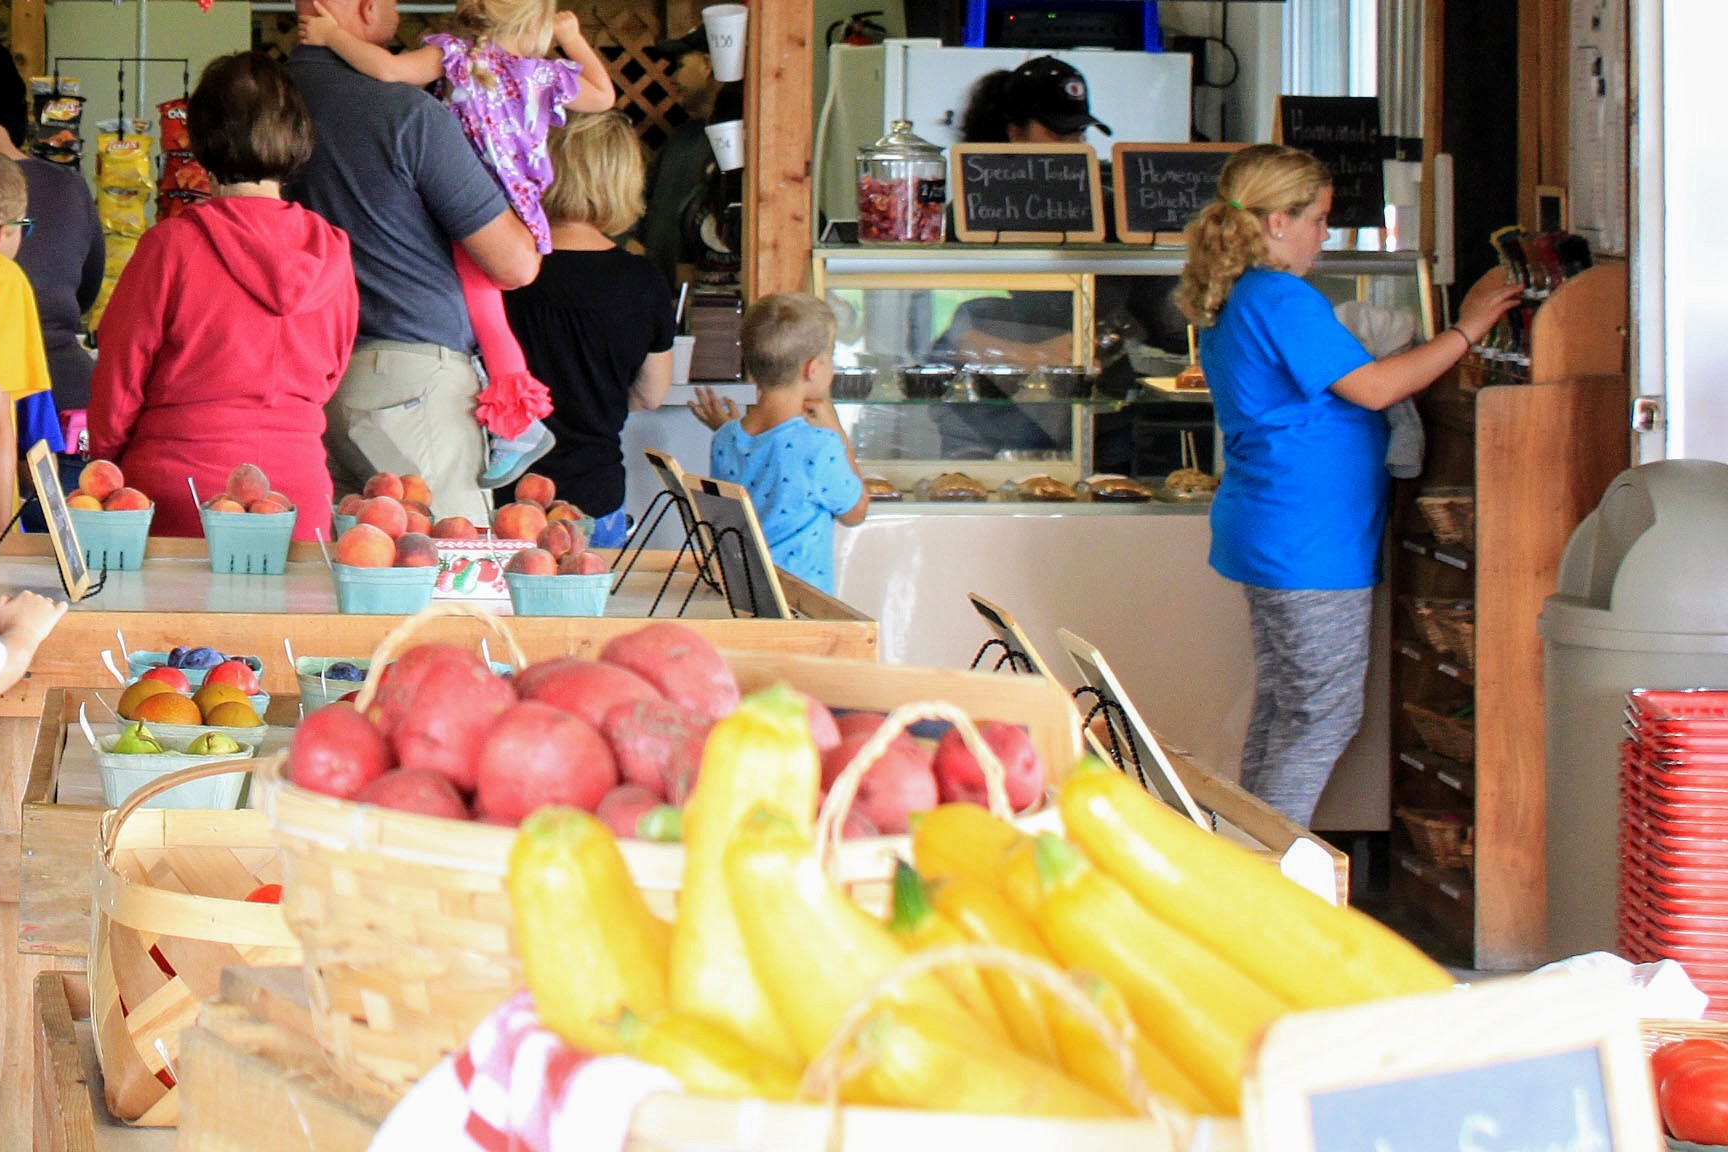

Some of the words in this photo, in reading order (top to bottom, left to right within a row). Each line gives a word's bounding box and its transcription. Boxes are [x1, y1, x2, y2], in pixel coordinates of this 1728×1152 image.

[968, 155, 1034, 187] Special
[1038, 158, 1086, 192] Today
[967, 193, 1019, 221] Peach
[1025, 194, 1089, 221] Cobbler
